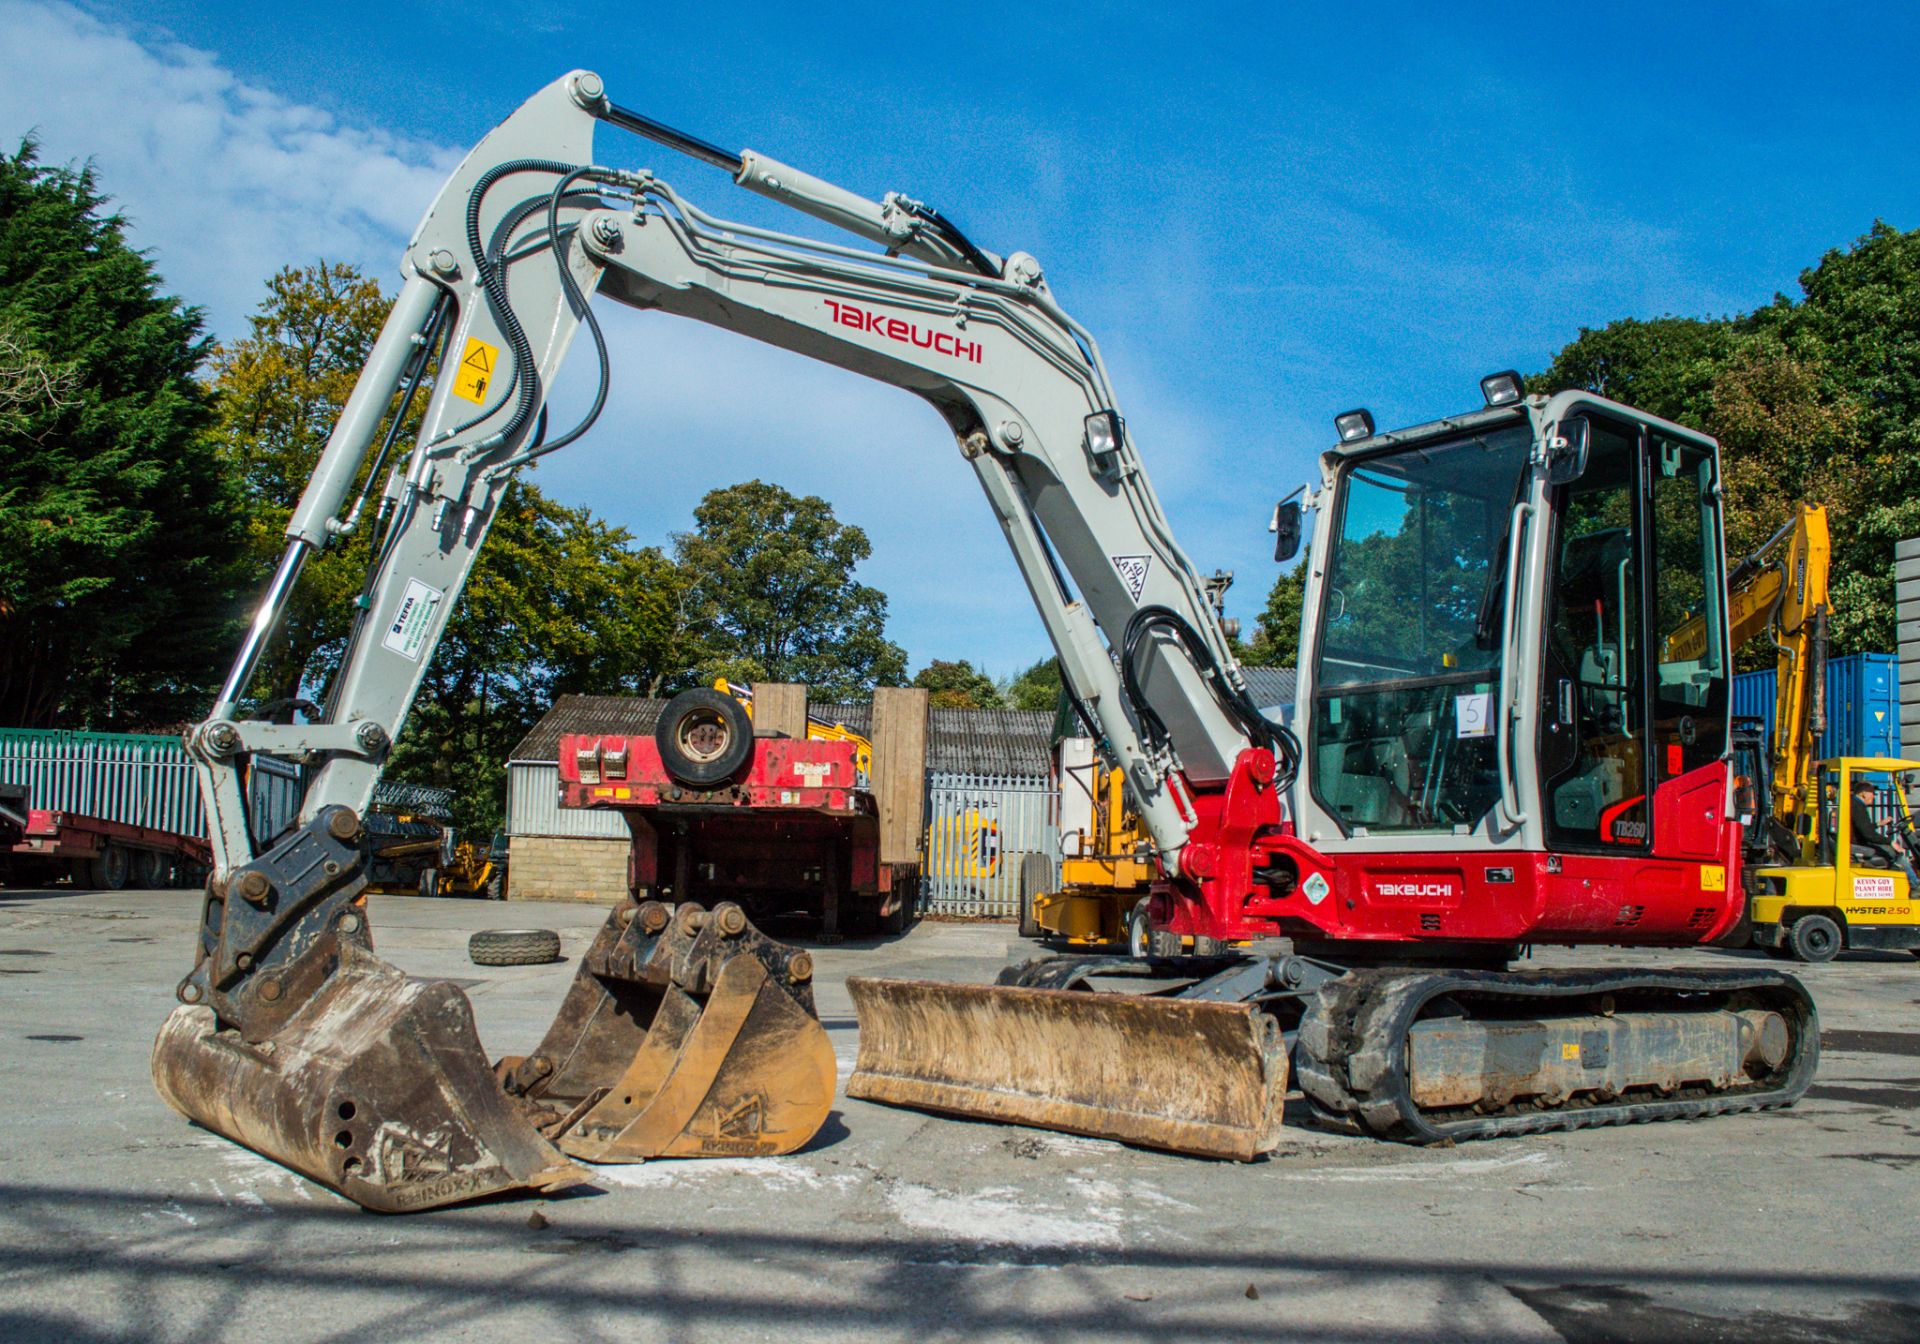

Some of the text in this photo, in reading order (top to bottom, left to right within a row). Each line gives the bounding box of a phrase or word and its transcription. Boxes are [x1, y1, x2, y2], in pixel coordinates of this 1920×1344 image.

[824, 299, 982, 364] TAKEUCHI
[398, 597, 414, 624] TEFRA
[1466, 697, 1480, 724] 5
[1615, 820, 1646, 838] TB260
[1375, 883, 1452, 897] TAKEUCHI
[1846, 906, 1911, 915] HYSTER 2.50
